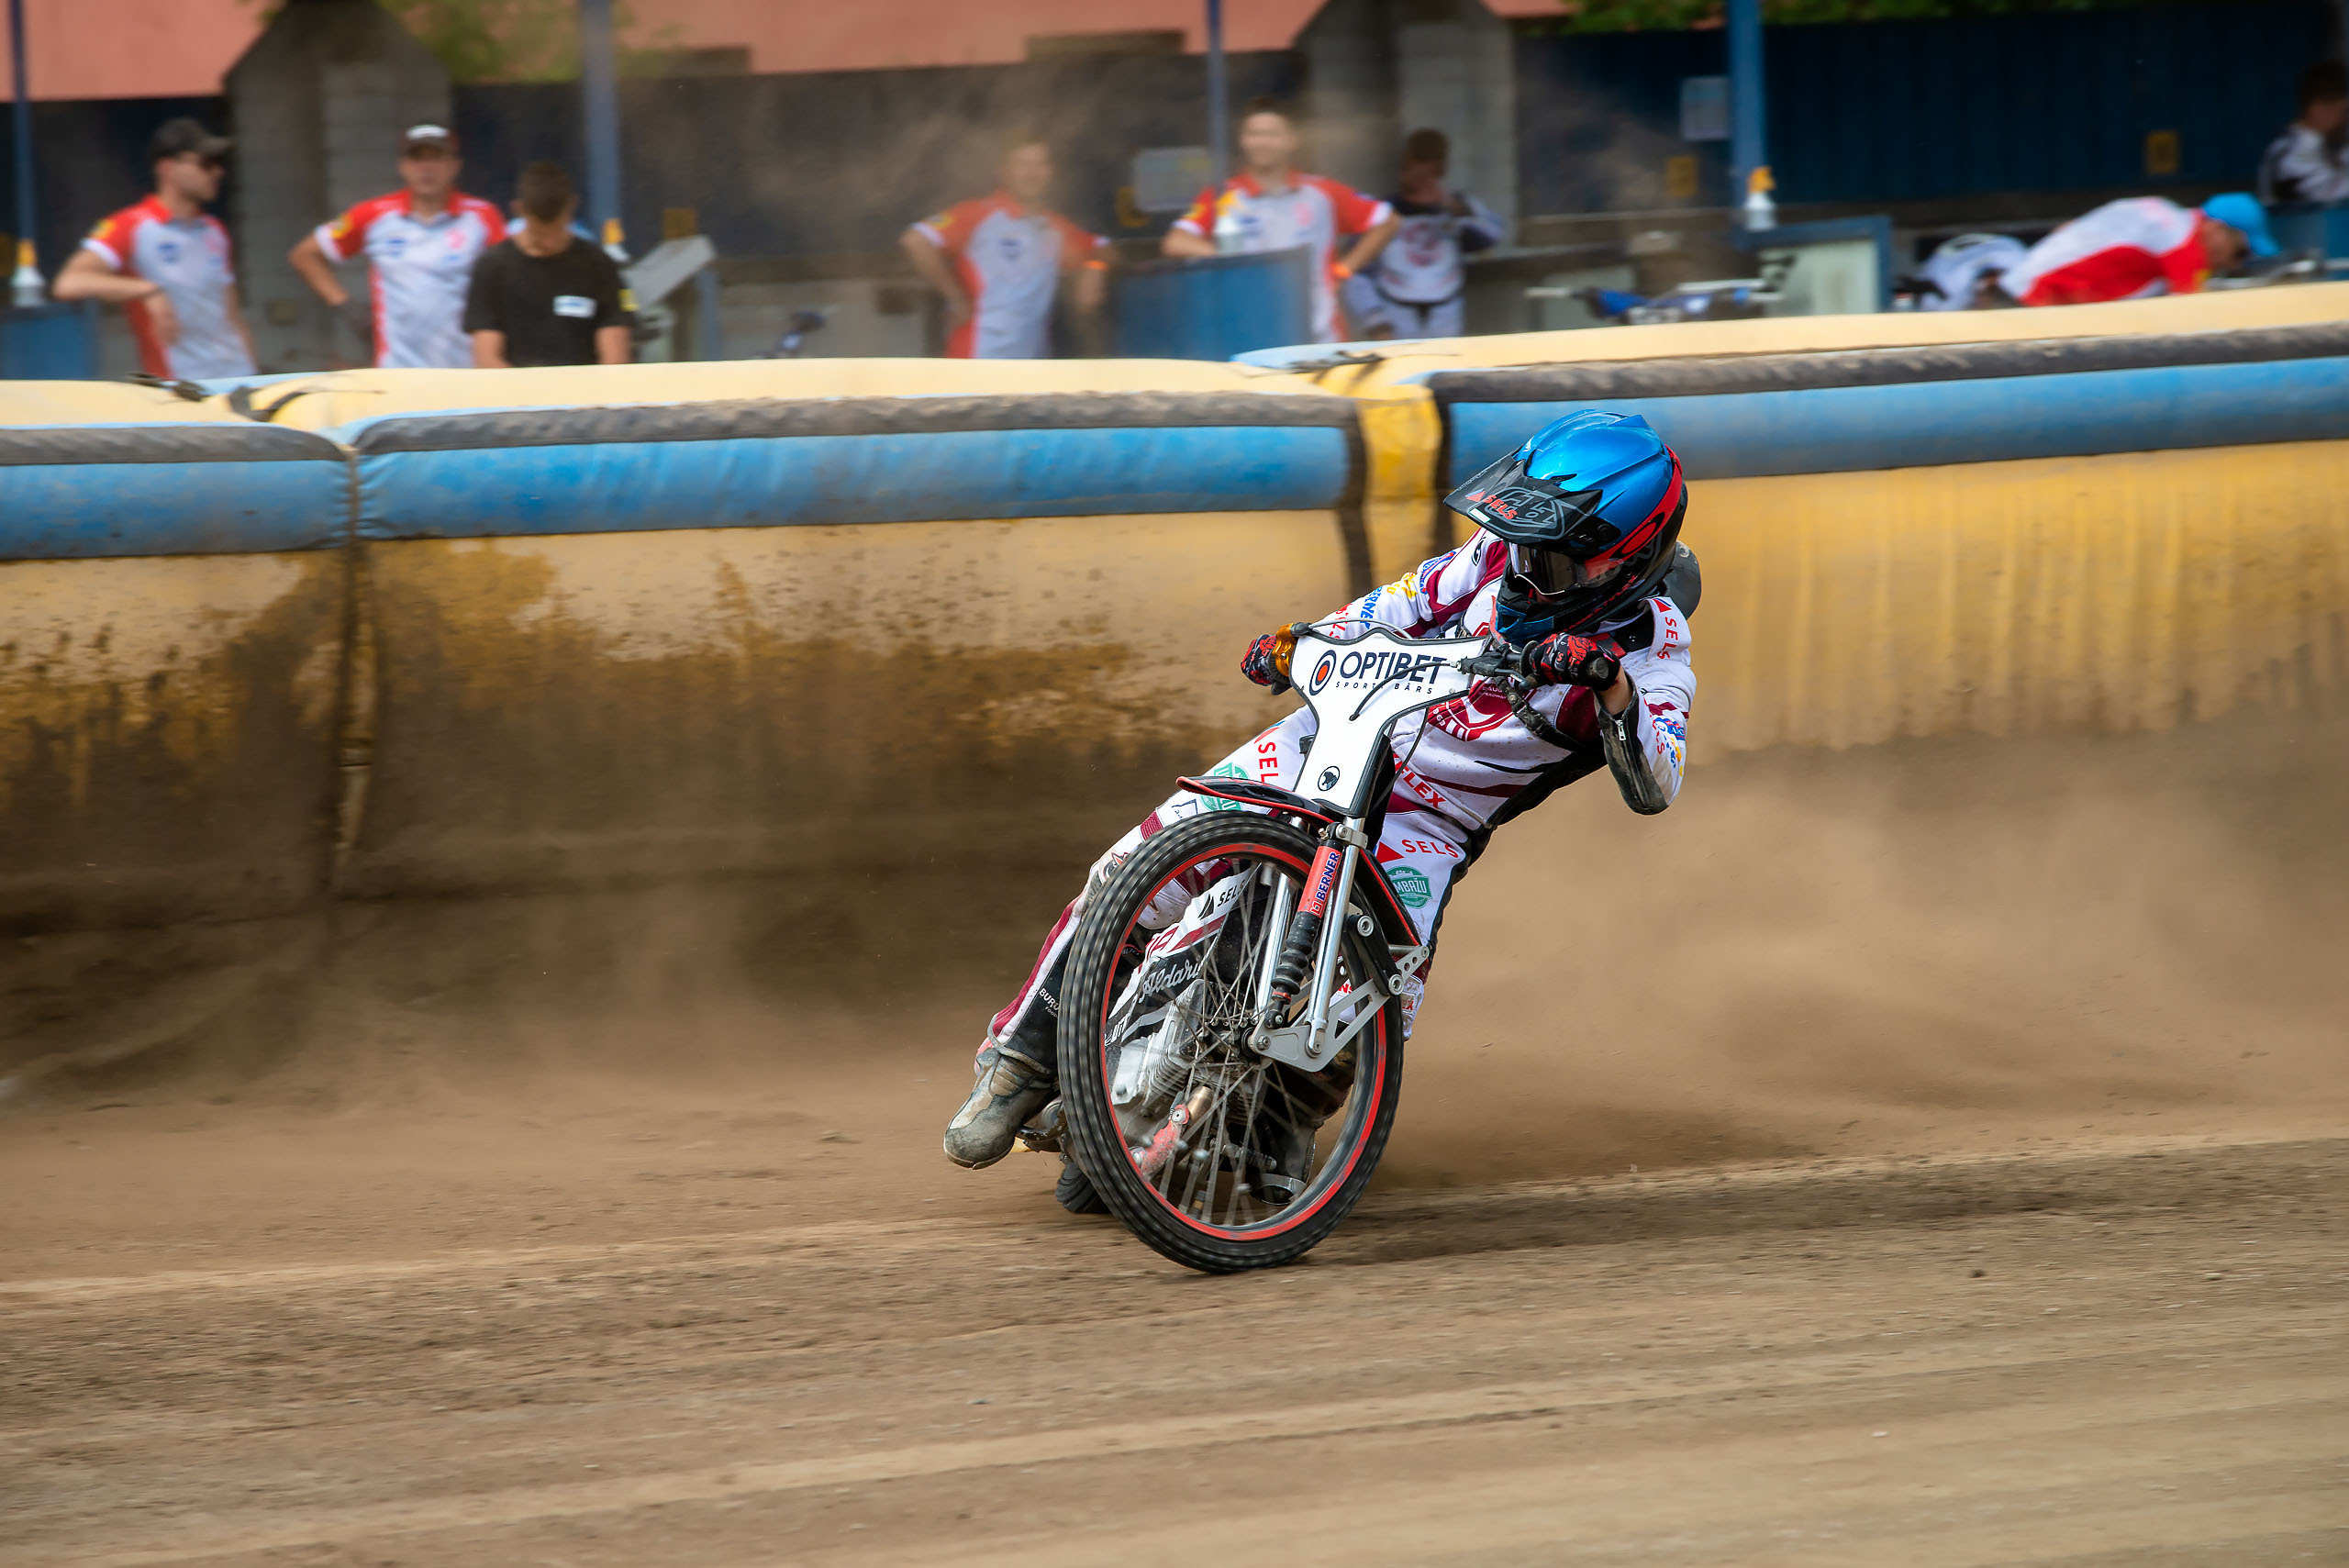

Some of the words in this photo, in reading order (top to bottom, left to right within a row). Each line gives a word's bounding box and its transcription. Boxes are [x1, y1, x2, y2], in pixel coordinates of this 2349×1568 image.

[1483, 494, 1519, 520] SELS
[1656, 616, 1679, 660] SELS
[1340, 651, 1447, 684] OPTIBET
[1335, 681, 1385, 690] SPORT
[1258, 741, 1279, 783] SEL
[1393, 753, 1447, 809] FLEX
[1401, 839, 1459, 859] SELS
[1315, 851, 1341, 901] BERNER
[1395, 877, 1428, 895] MBAŽU
[1217, 879, 1246, 907] SELS
